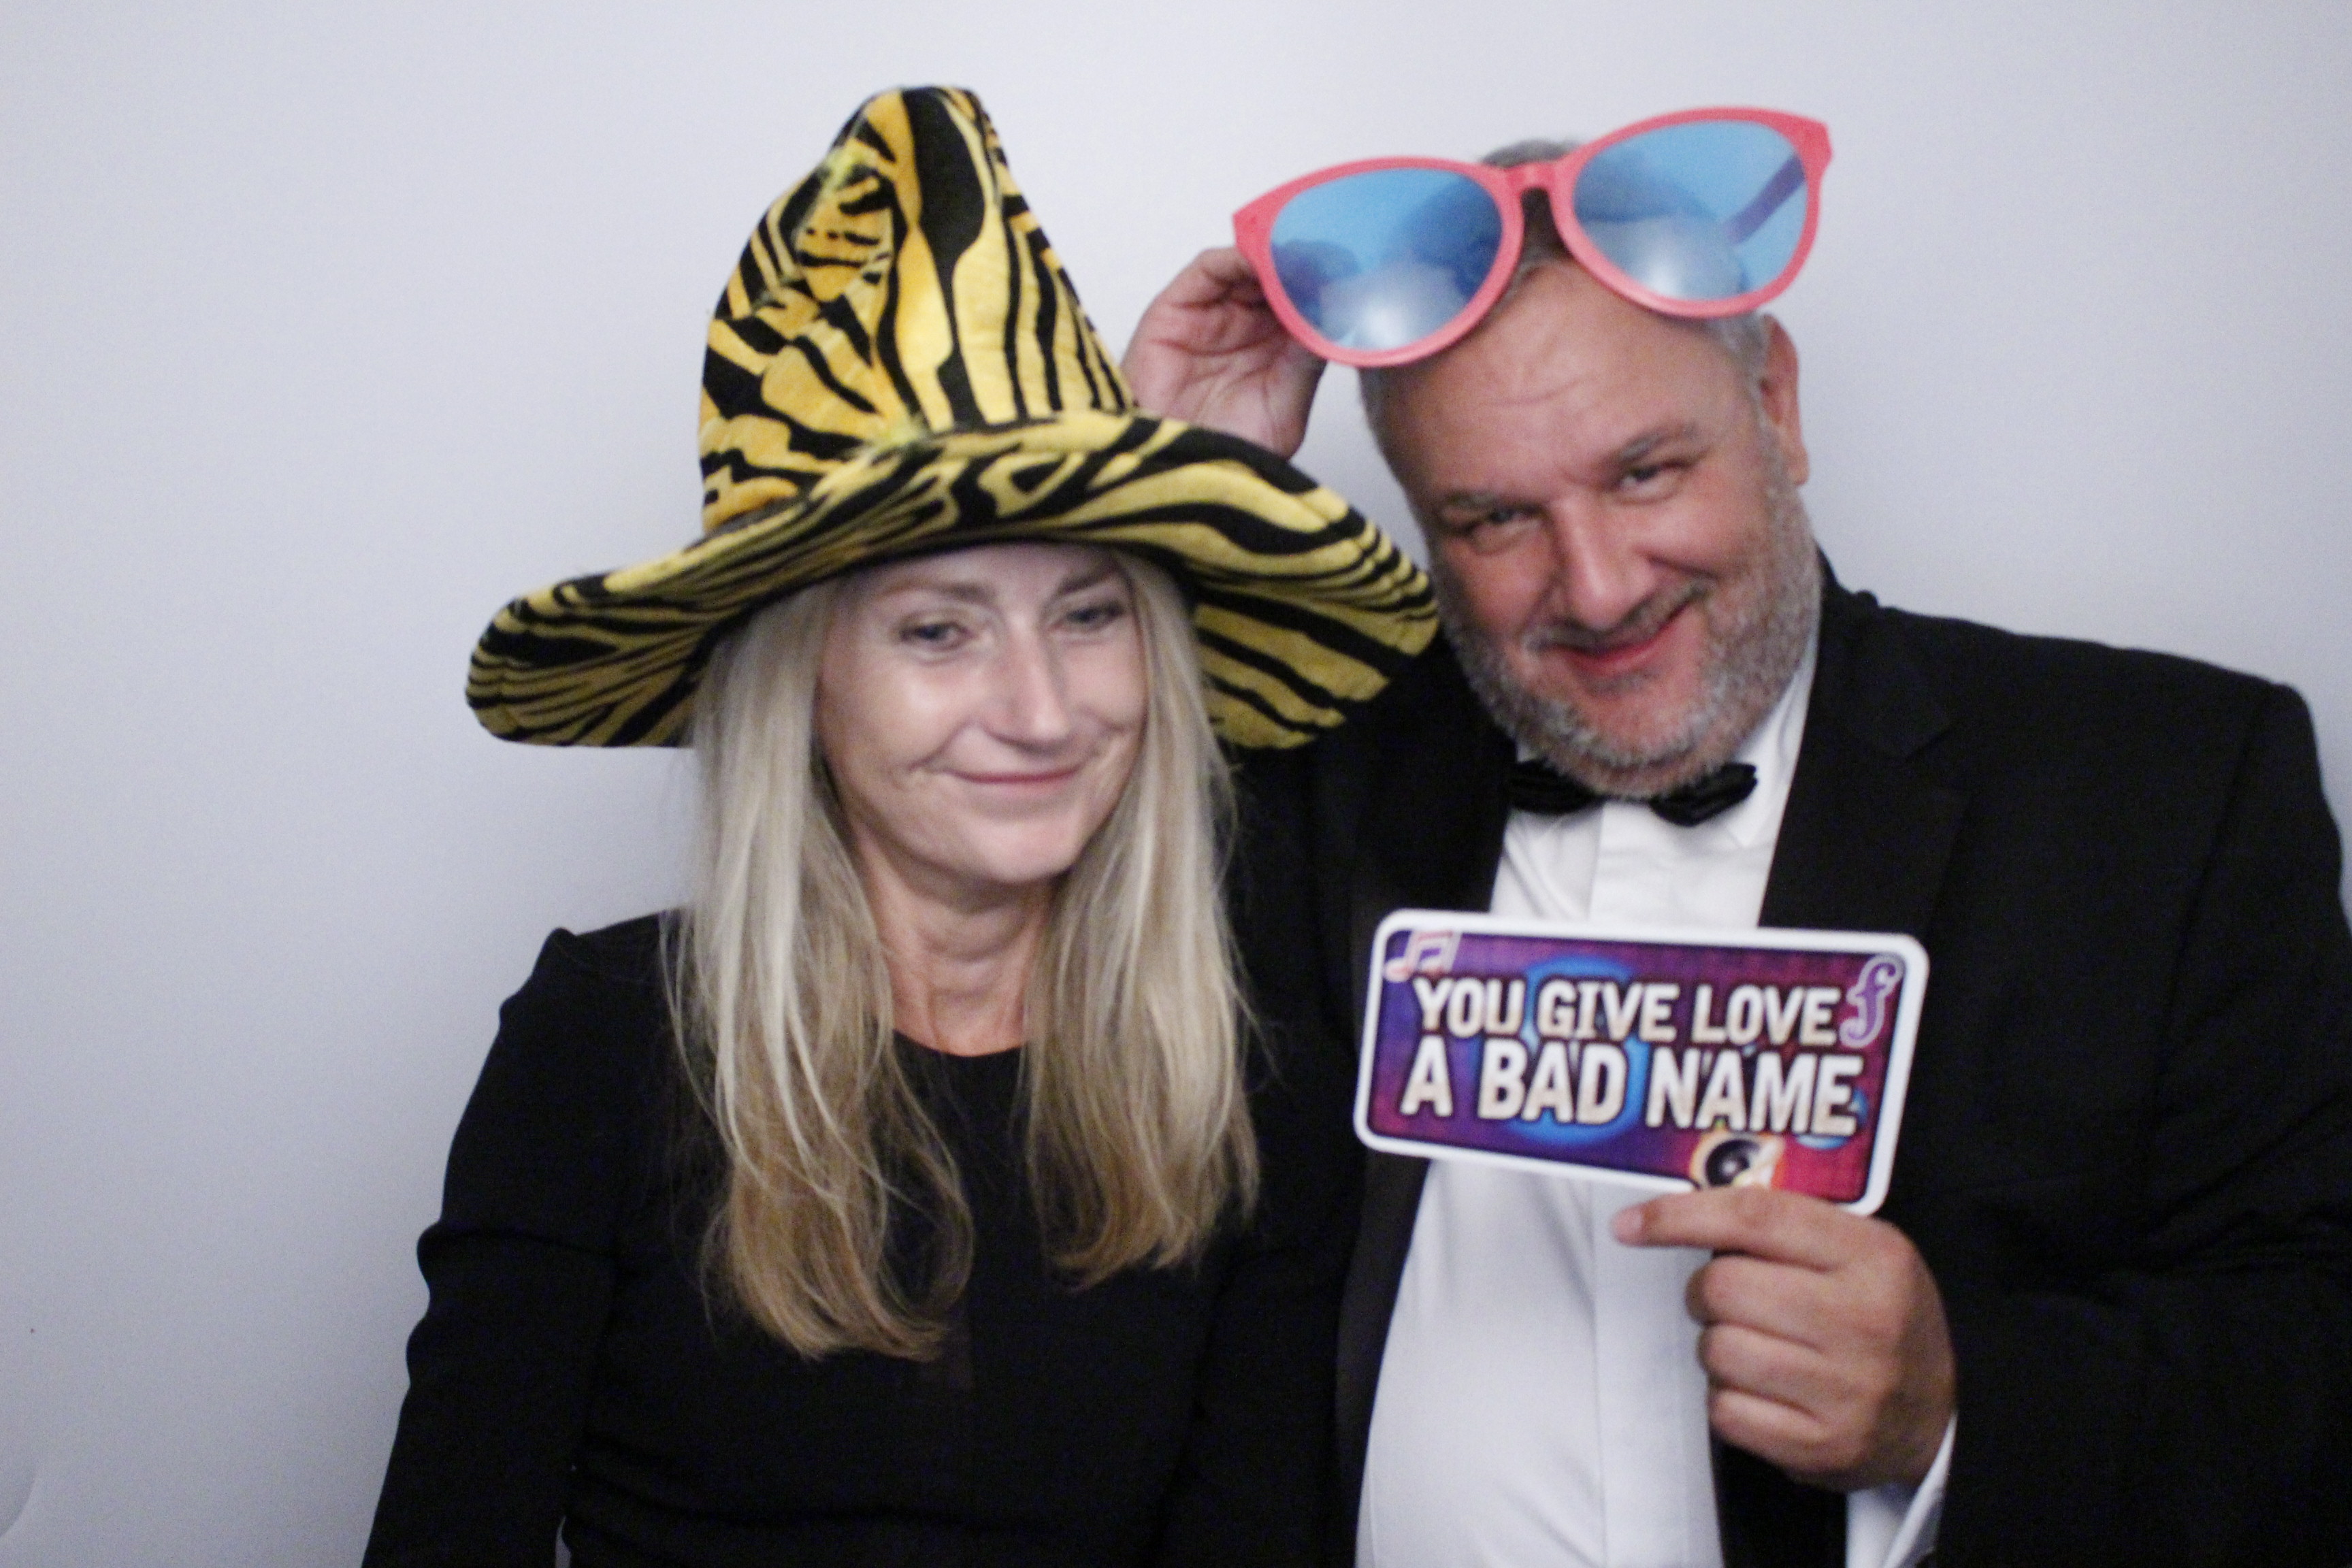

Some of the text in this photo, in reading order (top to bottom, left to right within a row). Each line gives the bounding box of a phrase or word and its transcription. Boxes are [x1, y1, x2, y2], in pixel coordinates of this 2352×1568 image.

[1413, 977, 1841, 1046] YOU GIVE LOVE
[1400, 1036, 1863, 1135] A BAD NAME
